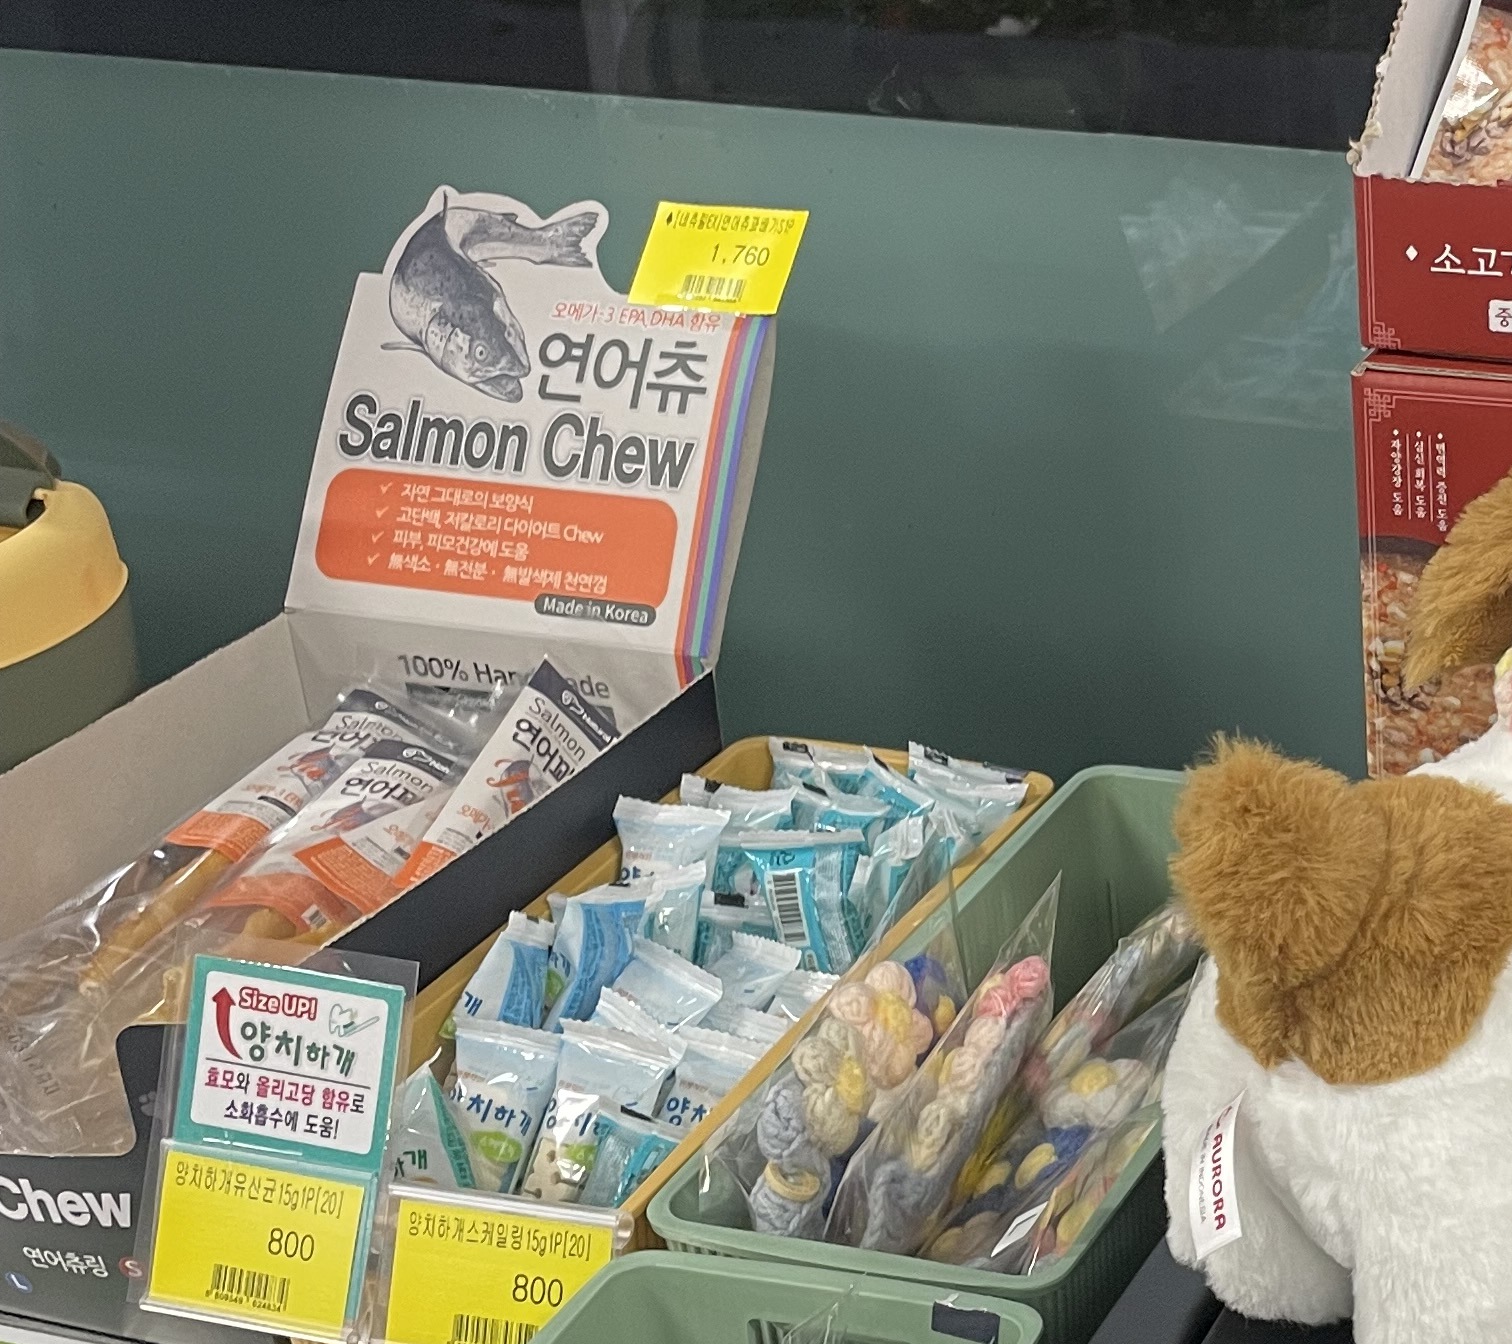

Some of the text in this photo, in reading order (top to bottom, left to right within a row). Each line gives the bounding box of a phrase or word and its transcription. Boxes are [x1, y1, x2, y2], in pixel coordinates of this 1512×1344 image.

[538, 331, 708, 416] 연어츄
[337, 393, 696, 490] Salmon Chew
[400, 483, 431, 503] 자연
[543, 596, 650, 625] Made in Korea
[397, 654, 469, 683] 100%
[528, 695, 588, 763] Salmon
[238, 986, 319, 1021] Size UP!
[240, 1020, 356, 1077] 양치하개
[204, 1067, 365, 1115] 효모와 올리고당 함유로
[223, 1100, 340, 1140] 소화흡수에 도움!
[0, 1175, 132, 1228] Chew
[1211, 1132, 1227, 1231] AURORA
[267, 1227, 315, 1261] 800
[512, 1274, 564, 1307] 800
